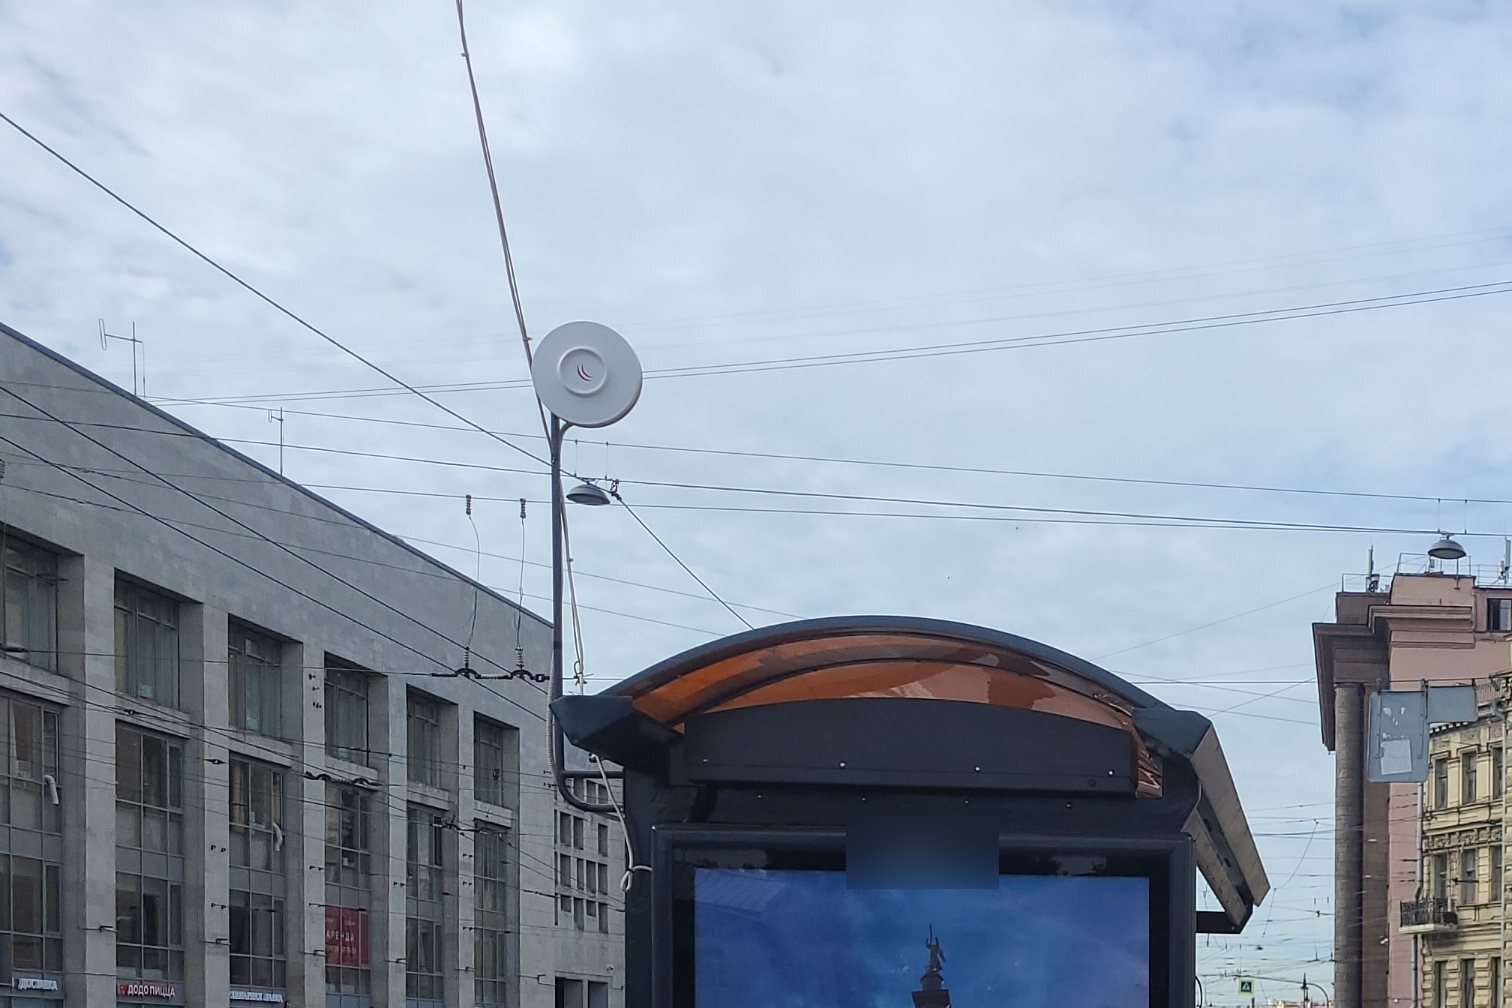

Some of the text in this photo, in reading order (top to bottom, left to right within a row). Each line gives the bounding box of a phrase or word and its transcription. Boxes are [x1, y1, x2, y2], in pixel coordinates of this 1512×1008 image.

[326, 930, 354, 942] АРЕНДА
[128, 984, 176, 998] ДОДО ПИЦЦА
